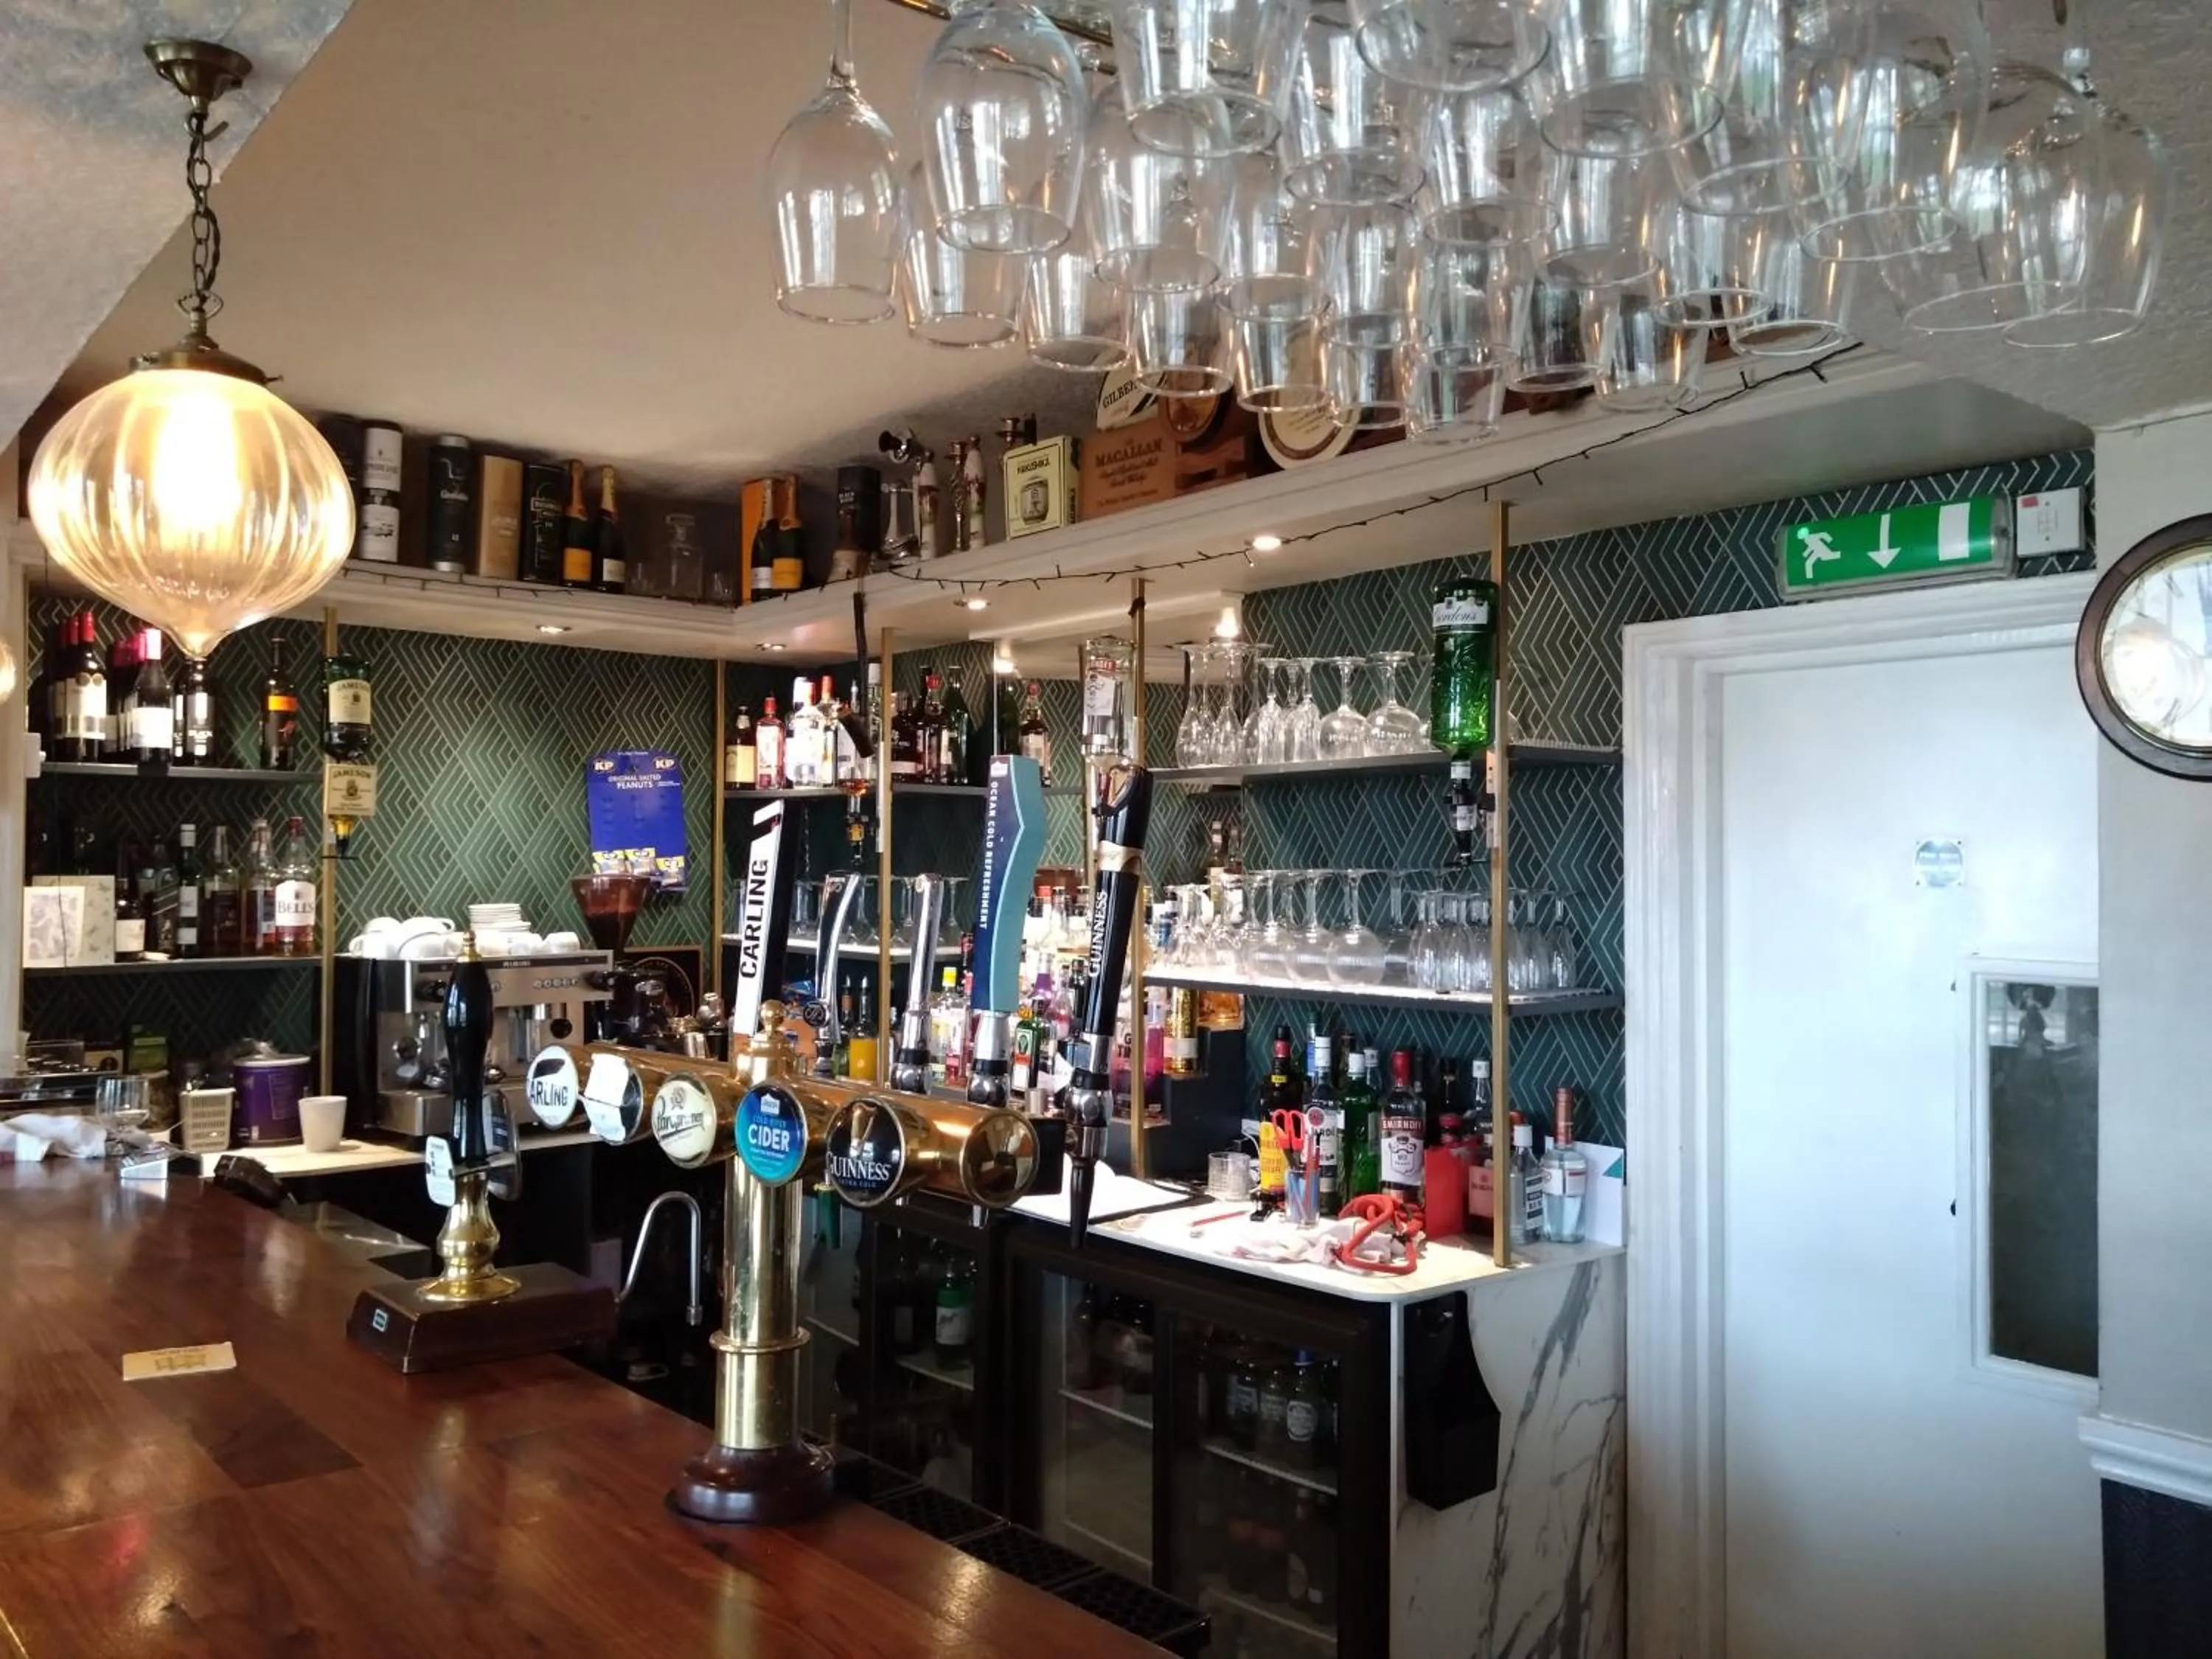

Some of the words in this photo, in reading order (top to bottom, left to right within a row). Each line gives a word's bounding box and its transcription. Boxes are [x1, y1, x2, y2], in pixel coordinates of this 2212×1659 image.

[333, 769, 372, 779] JAMESON
[594, 762, 614, 771] KP
[608, 774, 638, 782] ORIGINAL
[639, 773, 661, 782] SALTED
[655, 759, 675, 769] KP
[616, 781, 653, 790] PEANUTS
[988, 781, 998, 818] OCEAN
[986, 821, 995, 849] COLD
[979, 852, 995, 931] REFRESHMENT
[740, 859, 769, 979] CARLING
[1088, 889, 1107, 978] GUINNESS
[748, 1123, 790, 1152] CIDER
[1381, 1119, 1422, 1131] SMIRNOFF
[826, 1150, 891, 1182] GUINNESS
